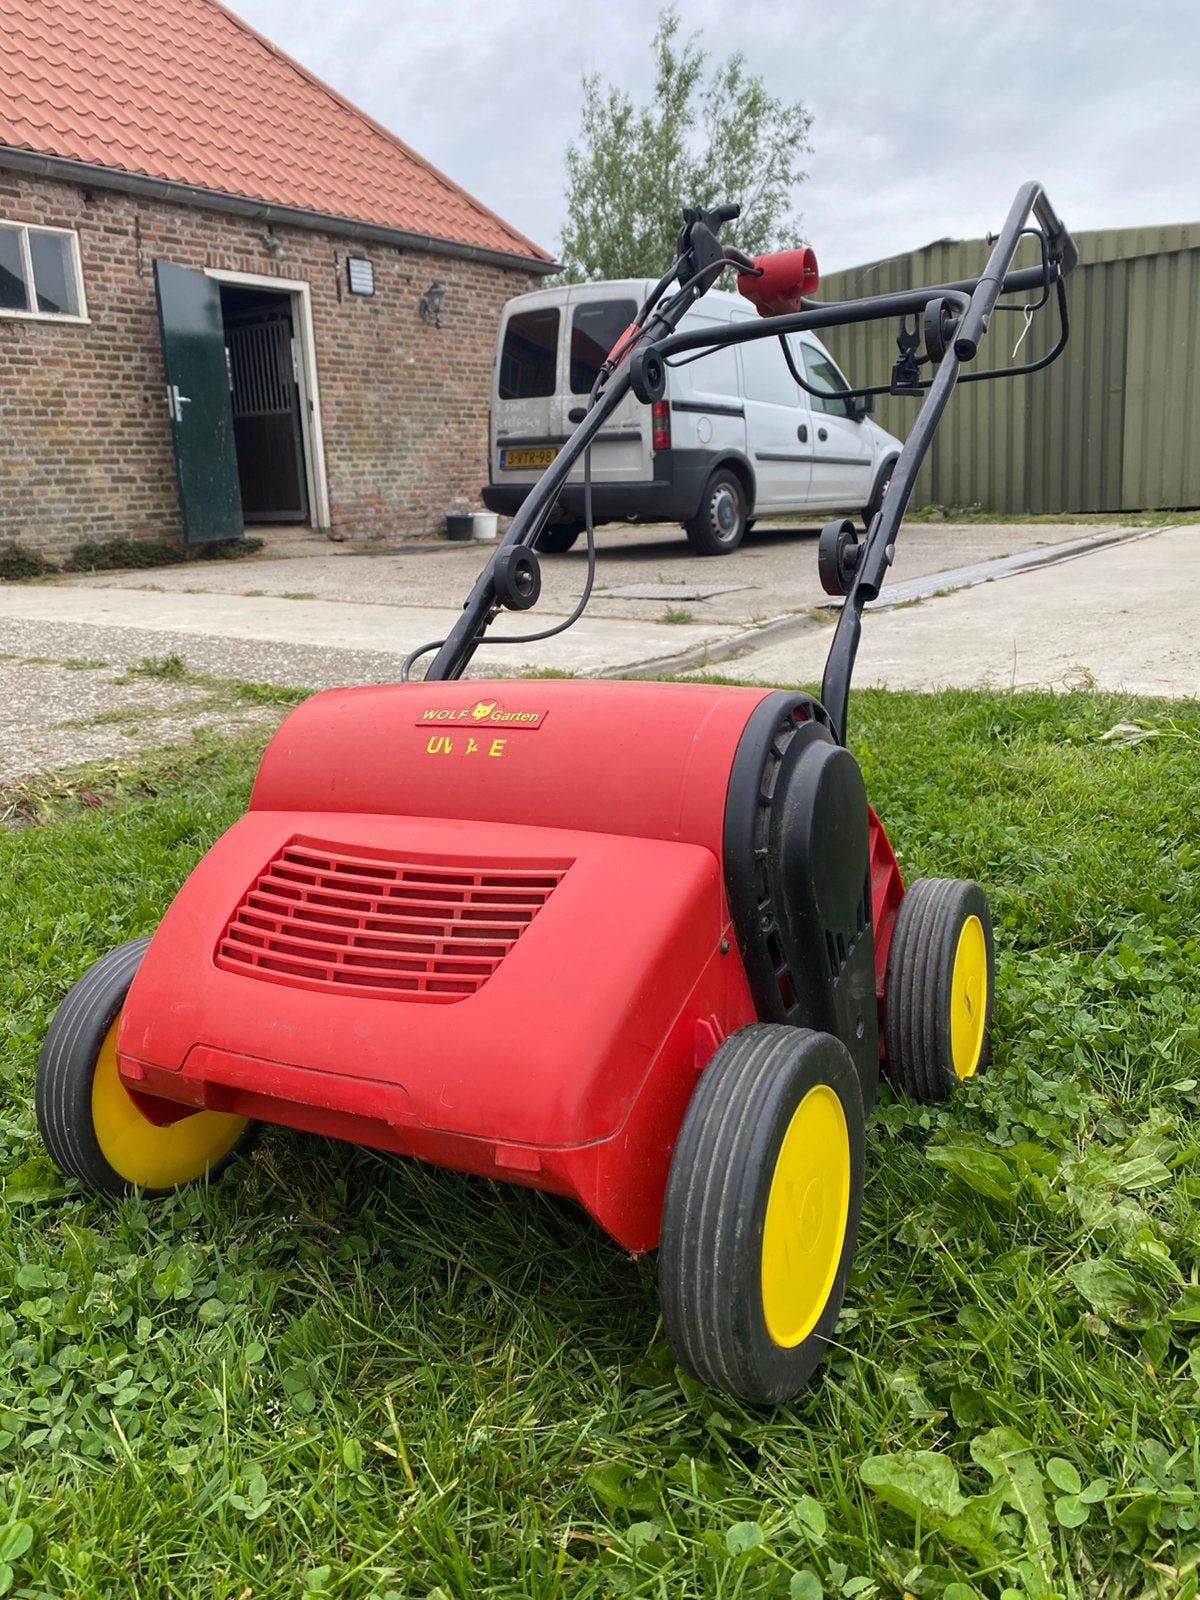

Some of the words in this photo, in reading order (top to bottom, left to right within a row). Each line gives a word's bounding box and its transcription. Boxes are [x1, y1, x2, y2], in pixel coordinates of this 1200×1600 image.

[507, 450, 552, 465] 3-VTR-98
[422, 709, 469, 720] WOLF
[490, 710, 540, 722] Garten
